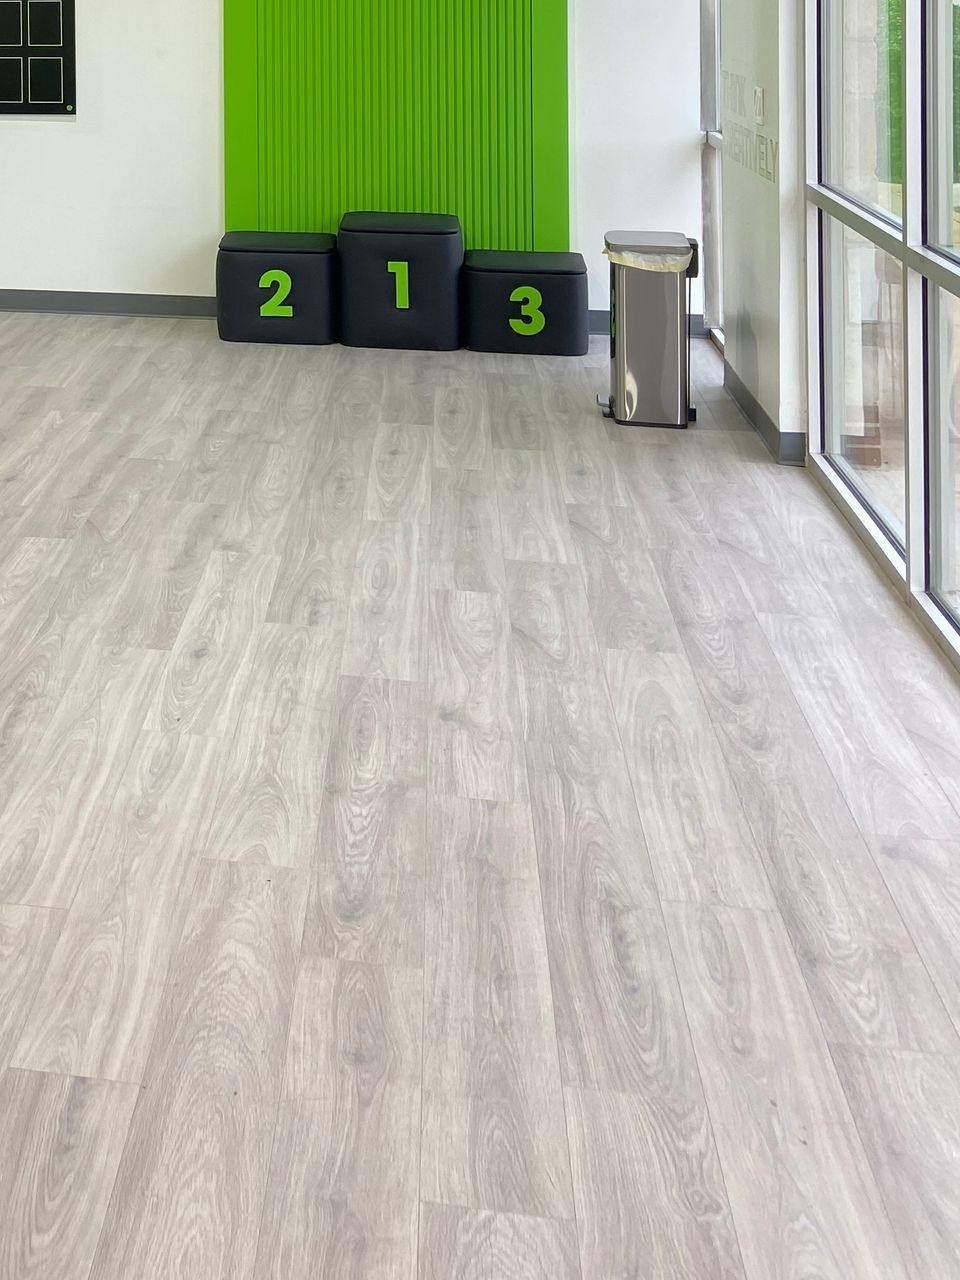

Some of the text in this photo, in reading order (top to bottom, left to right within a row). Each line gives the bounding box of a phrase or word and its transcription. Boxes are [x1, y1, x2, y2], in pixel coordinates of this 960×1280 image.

[258, 269, 294, 317] 2
[387, 261, 410, 309] 1
[508, 286, 546, 336] 3
